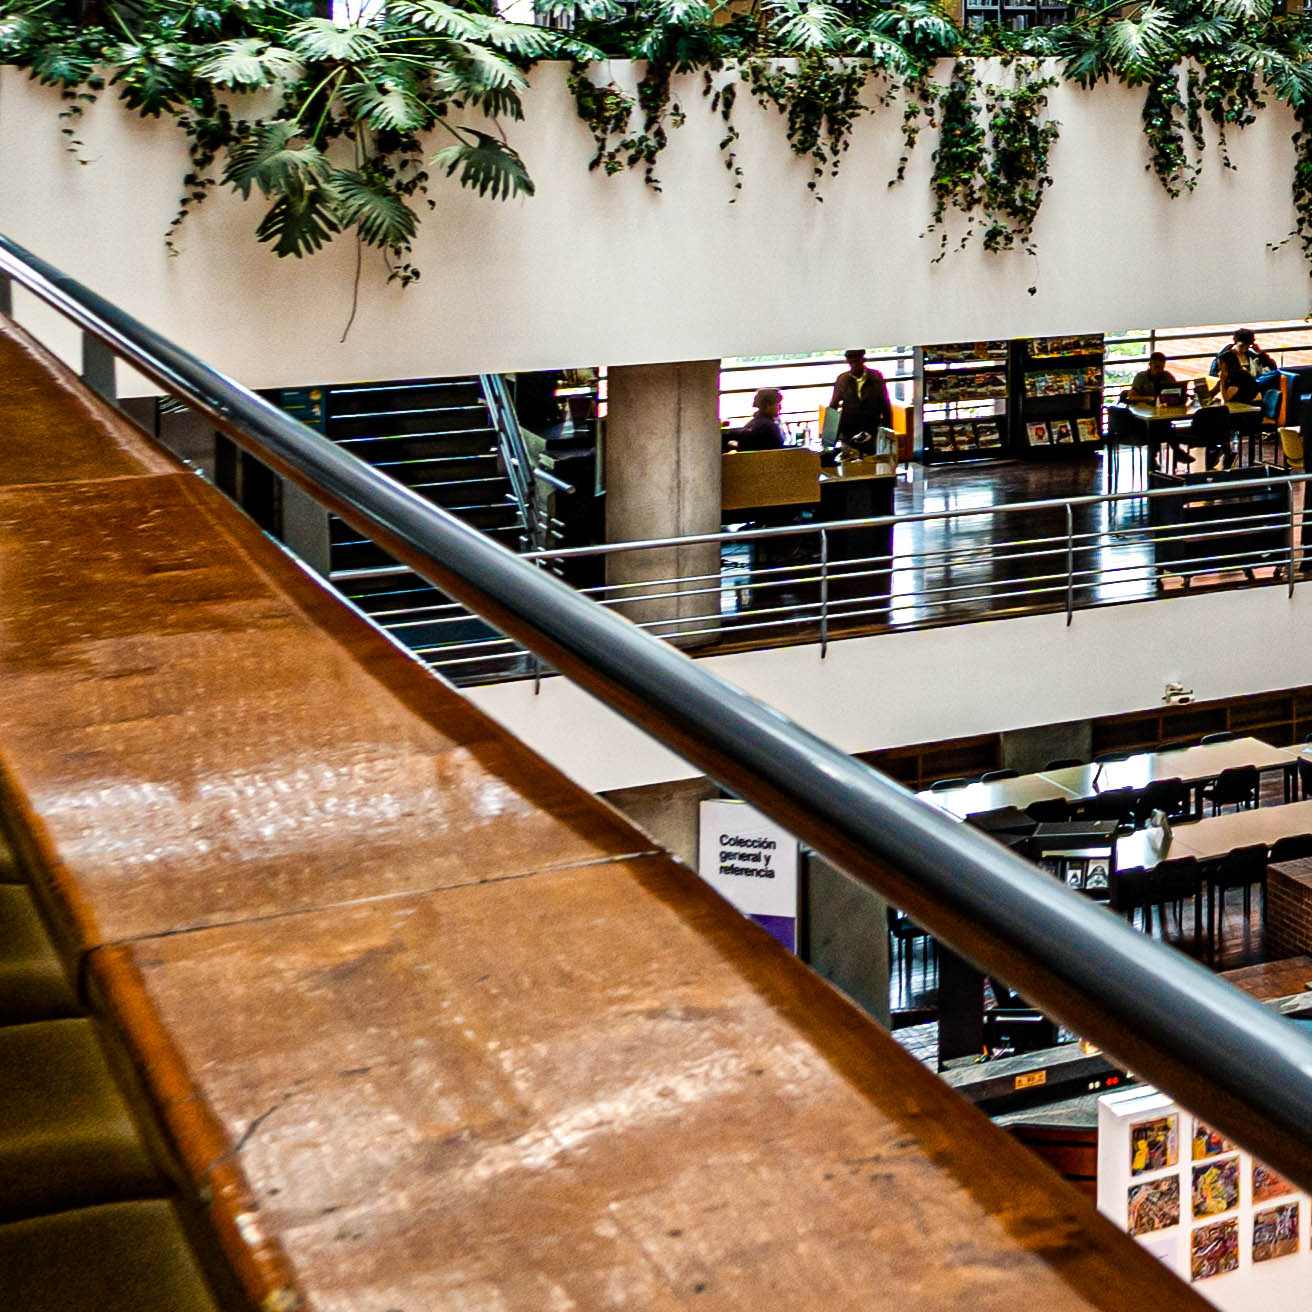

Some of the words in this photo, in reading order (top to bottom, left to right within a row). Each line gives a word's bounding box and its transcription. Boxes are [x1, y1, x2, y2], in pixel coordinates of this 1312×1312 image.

[719, 833, 777, 850] Colección
[719, 850, 762, 863] general
[764, 853, 772, 867] y
[719, 863, 776, 879] referencia
